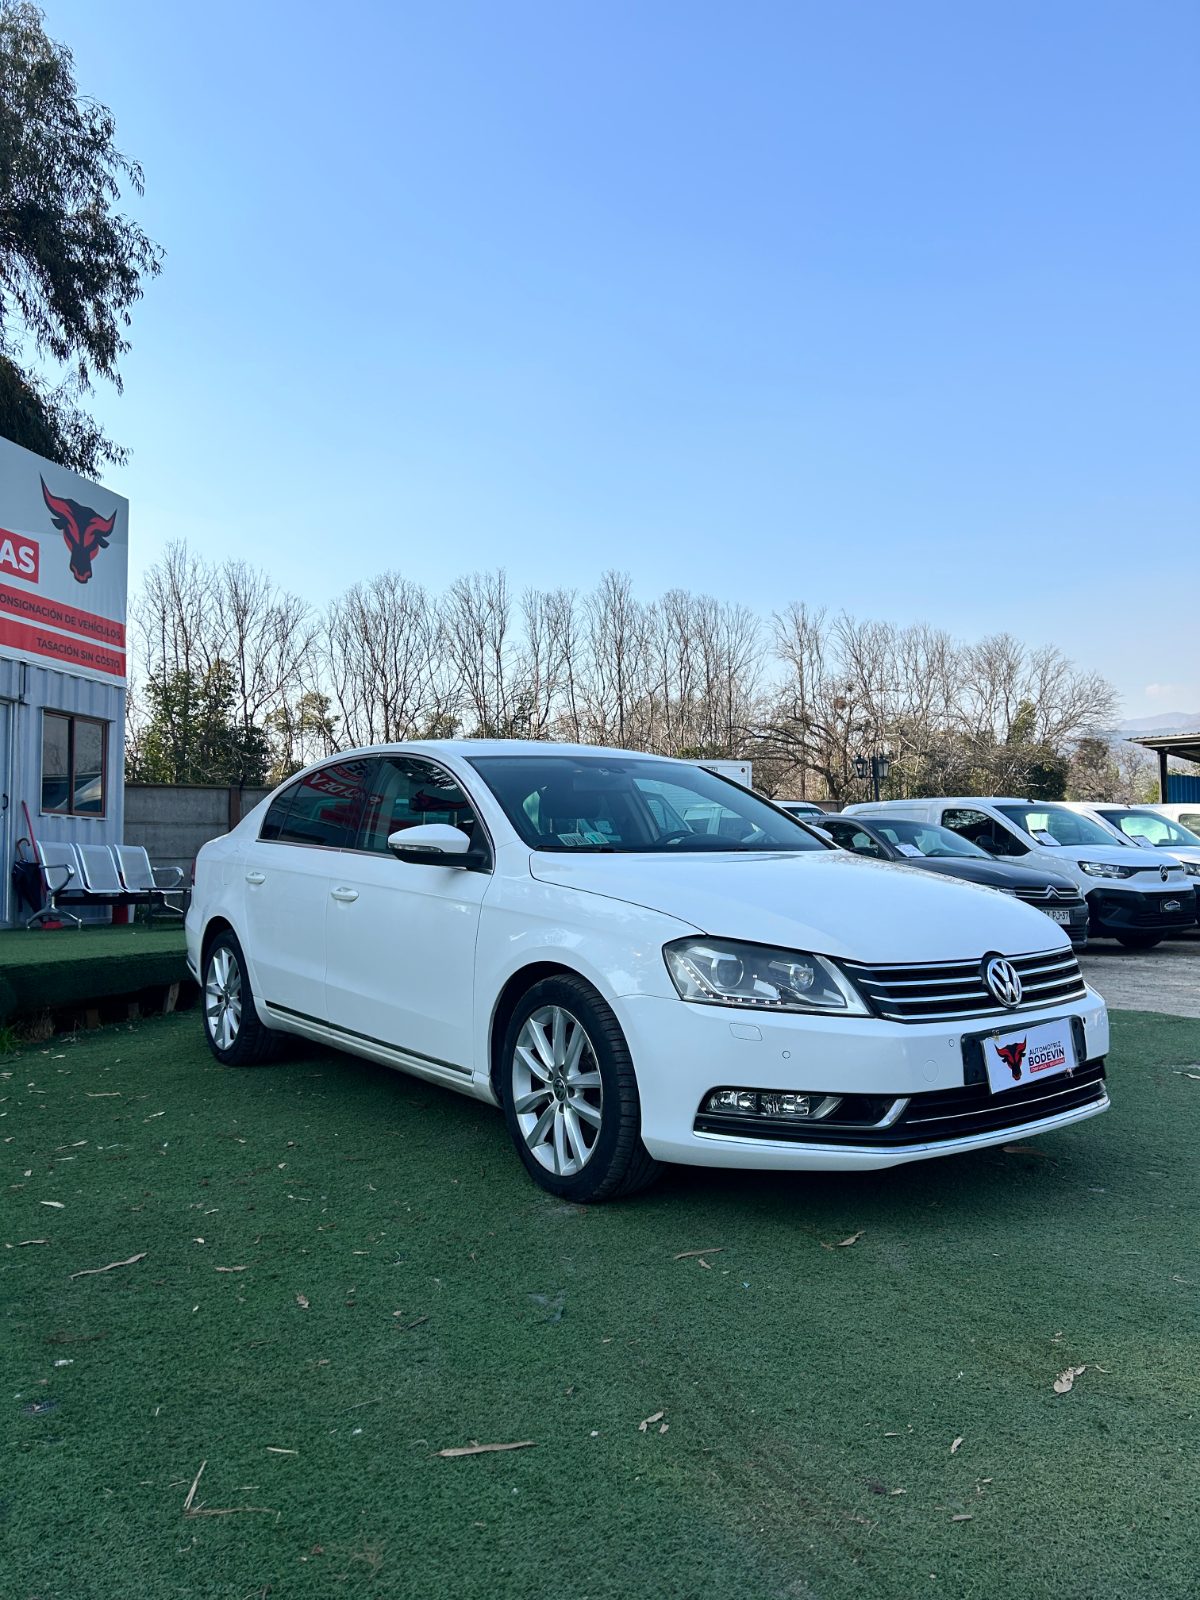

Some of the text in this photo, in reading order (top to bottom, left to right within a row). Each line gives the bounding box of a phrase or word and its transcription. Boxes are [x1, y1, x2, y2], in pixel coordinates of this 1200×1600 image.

[0, 539, 35, 574] AS
[65, 614, 76, 626] DE
[36, 637, 120, 669] TASACIÓN SIN COSTO
